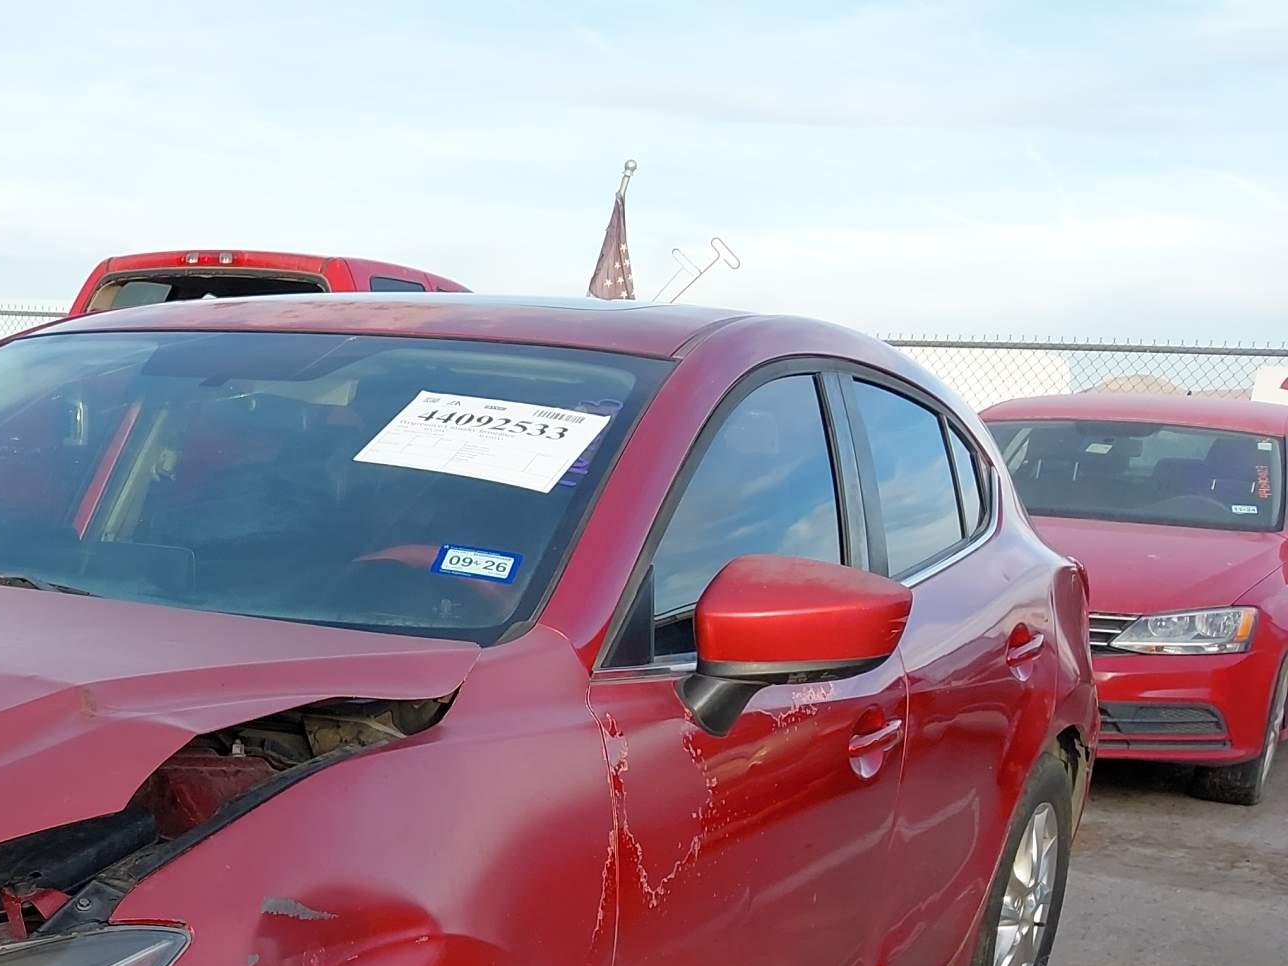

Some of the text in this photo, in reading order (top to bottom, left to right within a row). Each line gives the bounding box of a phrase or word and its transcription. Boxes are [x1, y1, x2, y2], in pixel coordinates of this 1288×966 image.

[418, 409, 569, 440] 44092533
[449, 555, 473, 567] 09
[483, 560, 508, 573] 26
